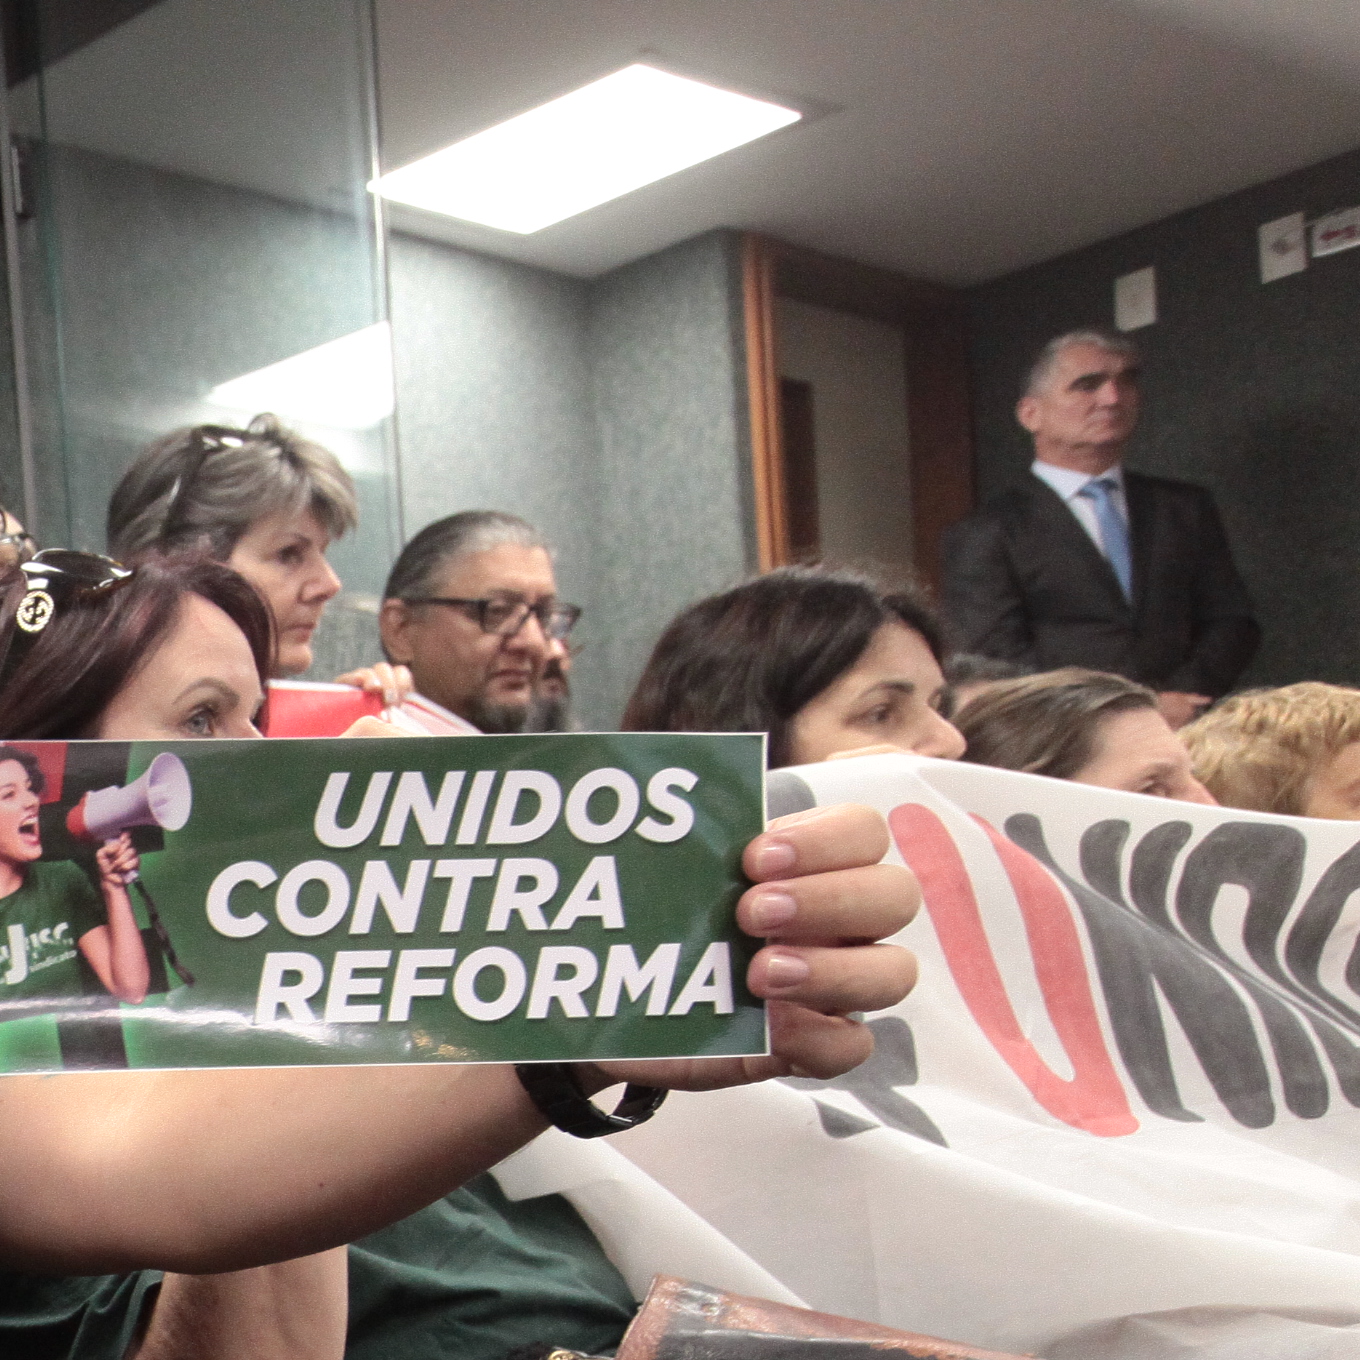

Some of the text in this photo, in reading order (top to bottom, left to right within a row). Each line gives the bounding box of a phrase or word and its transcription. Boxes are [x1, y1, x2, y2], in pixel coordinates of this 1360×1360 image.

[313, 767, 699, 848] UNIDOS
[205, 855, 626, 938] CONTRA
[253, 941, 735, 1024] REFORMA
